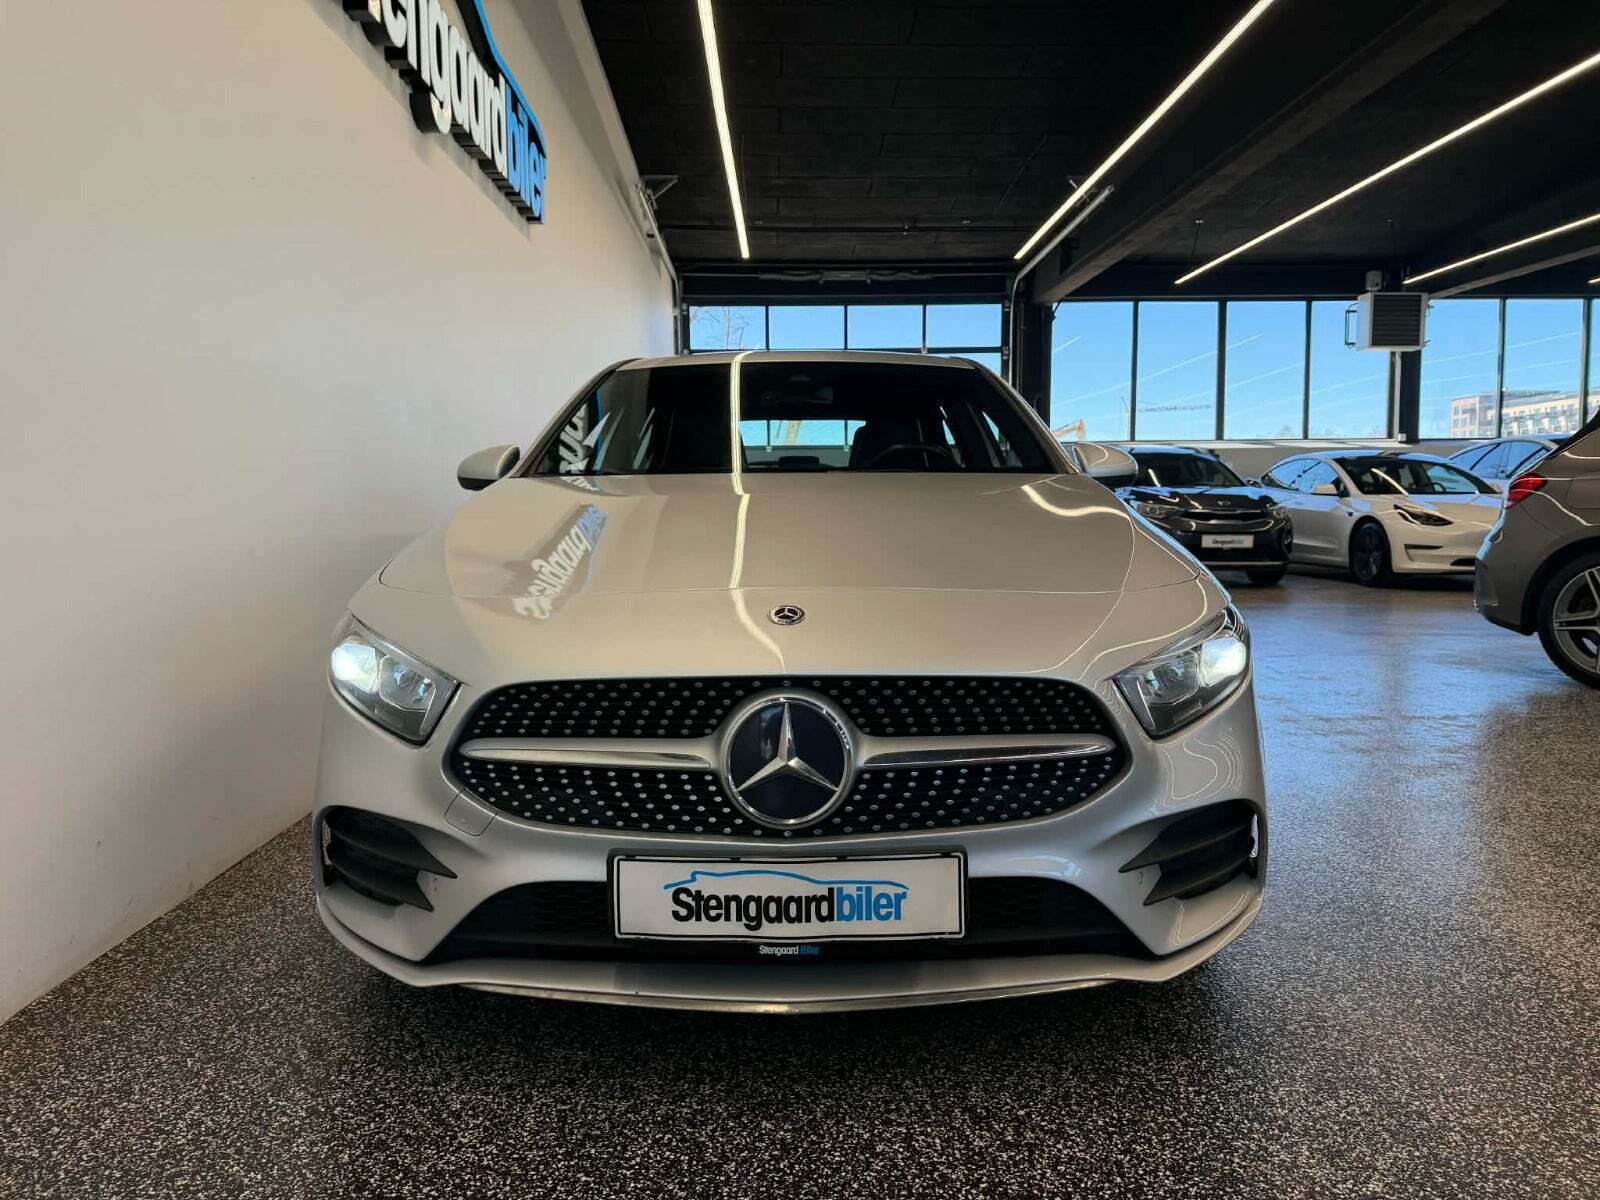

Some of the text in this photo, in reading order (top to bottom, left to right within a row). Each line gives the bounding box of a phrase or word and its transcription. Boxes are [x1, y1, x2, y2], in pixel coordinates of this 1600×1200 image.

[368, 0, 547, 224] engaardbiler
[672, 886, 907, 931] Stengaardbiler
[759, 945, 799, 956] Stengaard
